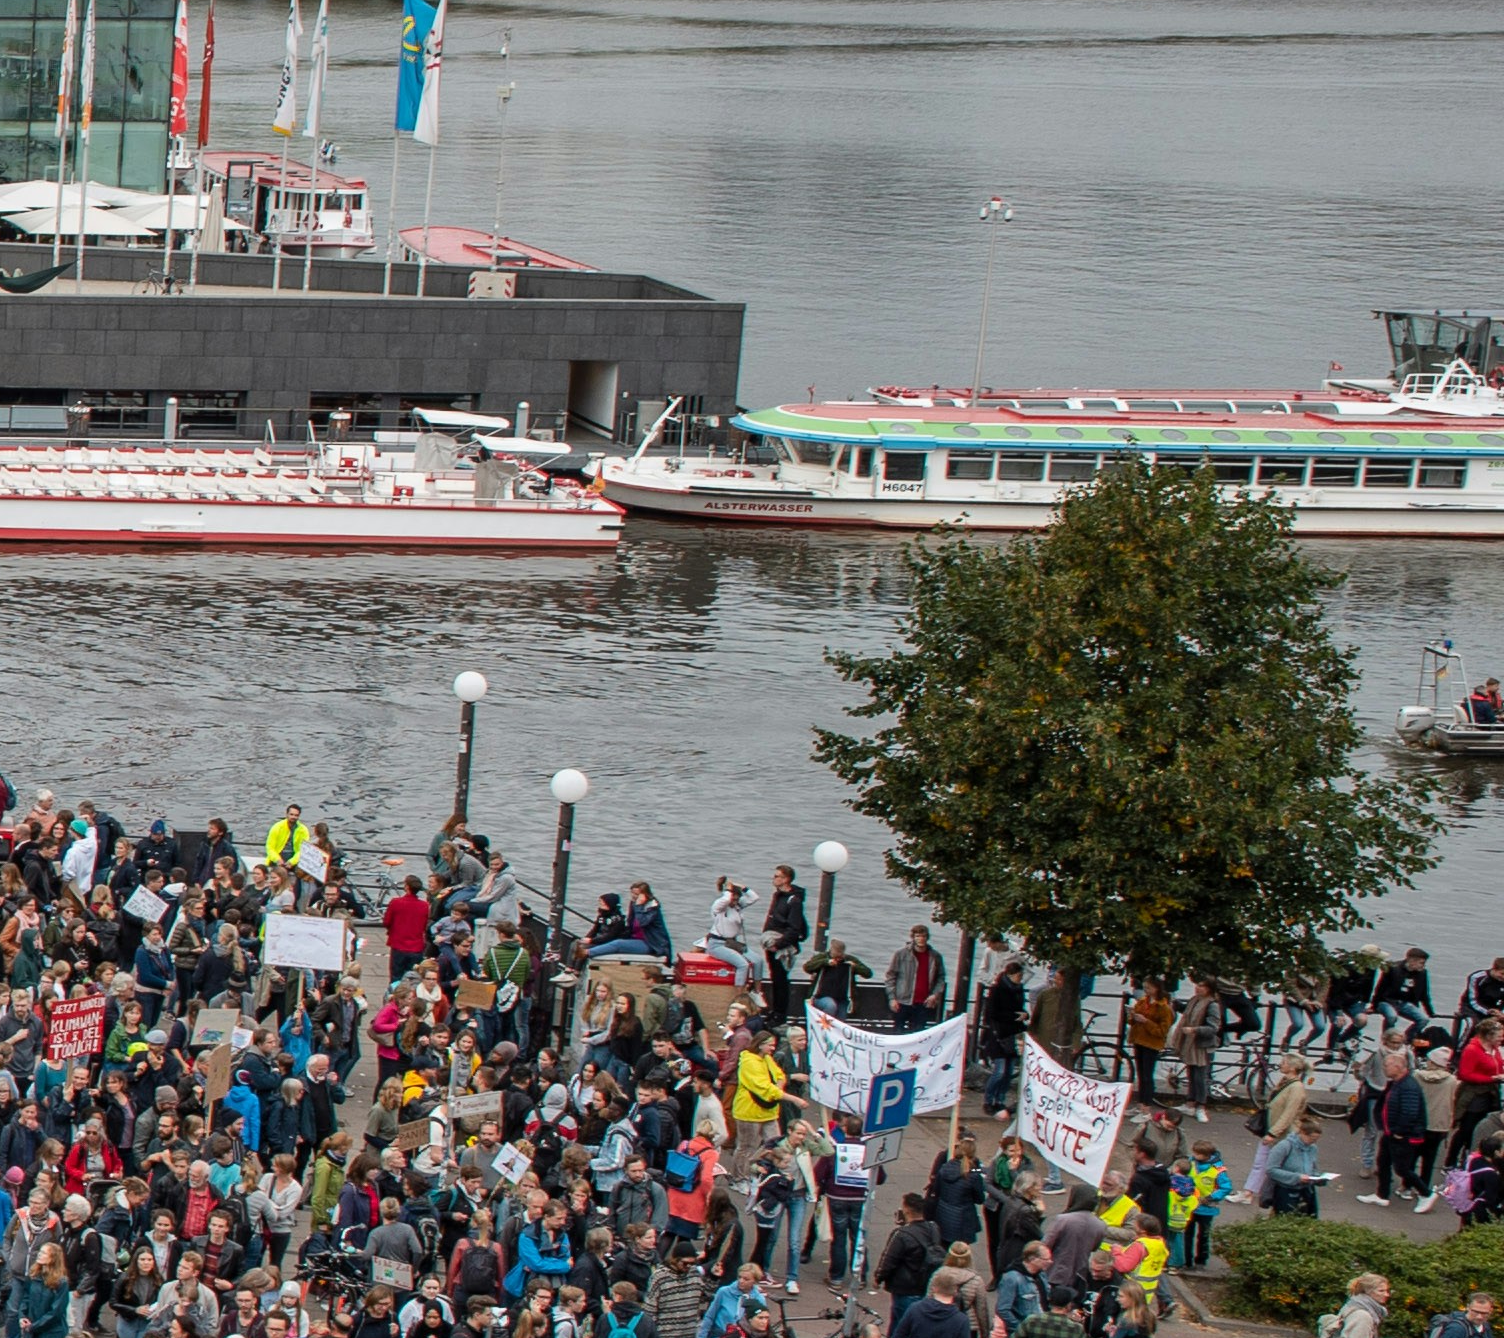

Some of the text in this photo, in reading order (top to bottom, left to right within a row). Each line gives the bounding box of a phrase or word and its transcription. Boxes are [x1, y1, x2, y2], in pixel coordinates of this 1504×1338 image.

[882, 484, 923, 493] H6047
[704, 501, 813, 513] ALSTERWASSER
[842, 1025, 886, 1048] OHNE
[813, 1024, 903, 1074] NATUR
[831, 1069, 871, 1091] KEINE
[878, 1079, 905, 1125] P
[1037, 1094, 1075, 1119] spielt
